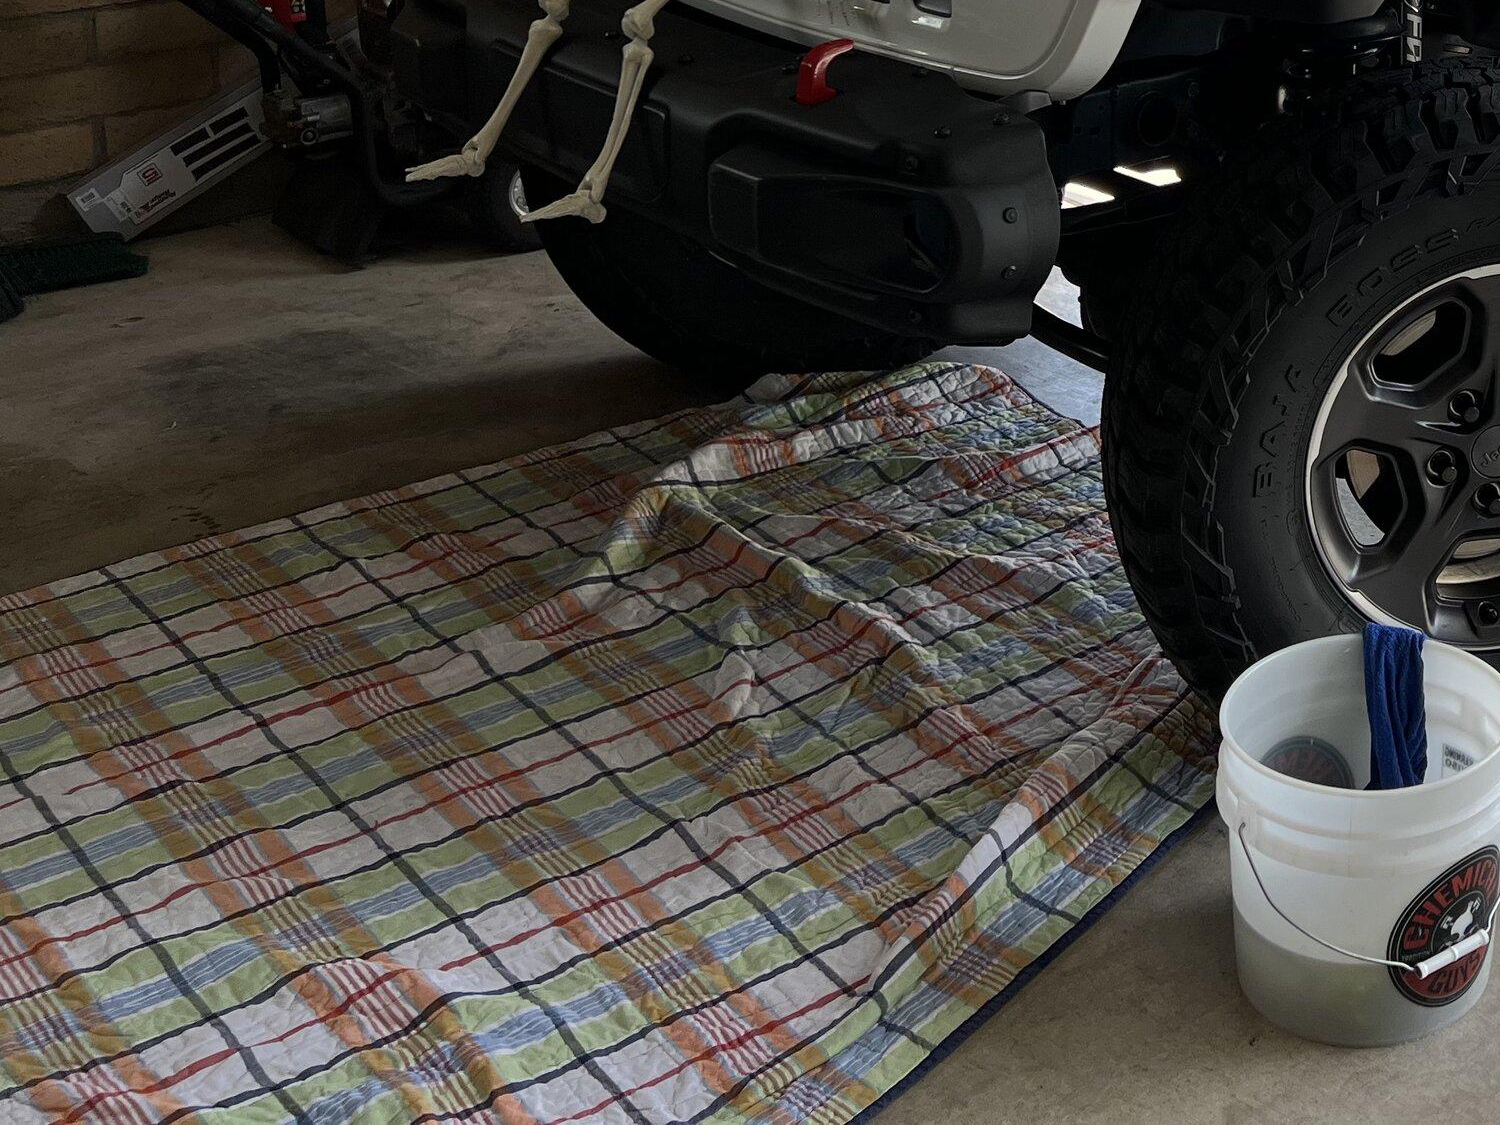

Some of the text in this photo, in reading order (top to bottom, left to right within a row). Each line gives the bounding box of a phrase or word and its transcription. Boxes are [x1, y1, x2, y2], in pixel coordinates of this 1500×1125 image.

[1253, 363, 1303, 499] BAJA
[1326, 228, 1460, 328] BOSS
[1428, 952, 1481, 995] GUYS
